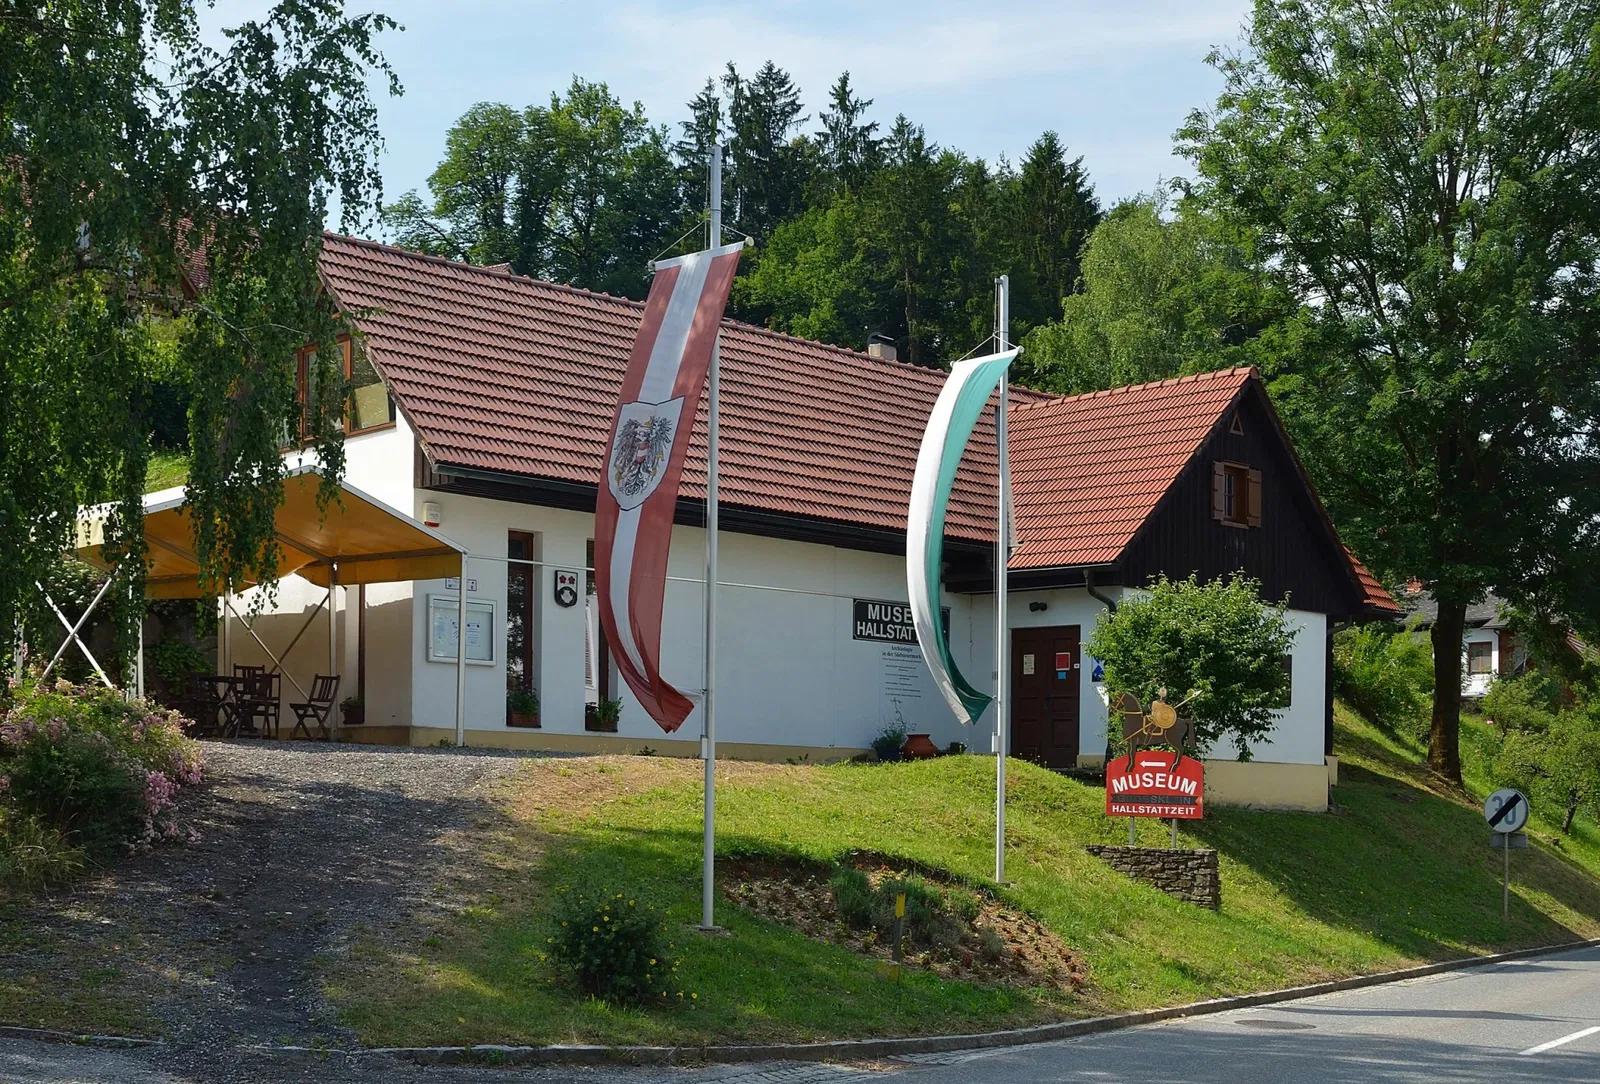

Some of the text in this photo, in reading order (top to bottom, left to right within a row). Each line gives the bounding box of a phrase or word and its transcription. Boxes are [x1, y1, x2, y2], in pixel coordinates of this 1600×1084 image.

[867, 604, 912, 623] MUSE
[1112, 772, 1197, 795] MUSEUM
[1112, 805, 1195, 815] HALLSTATTZEIT
